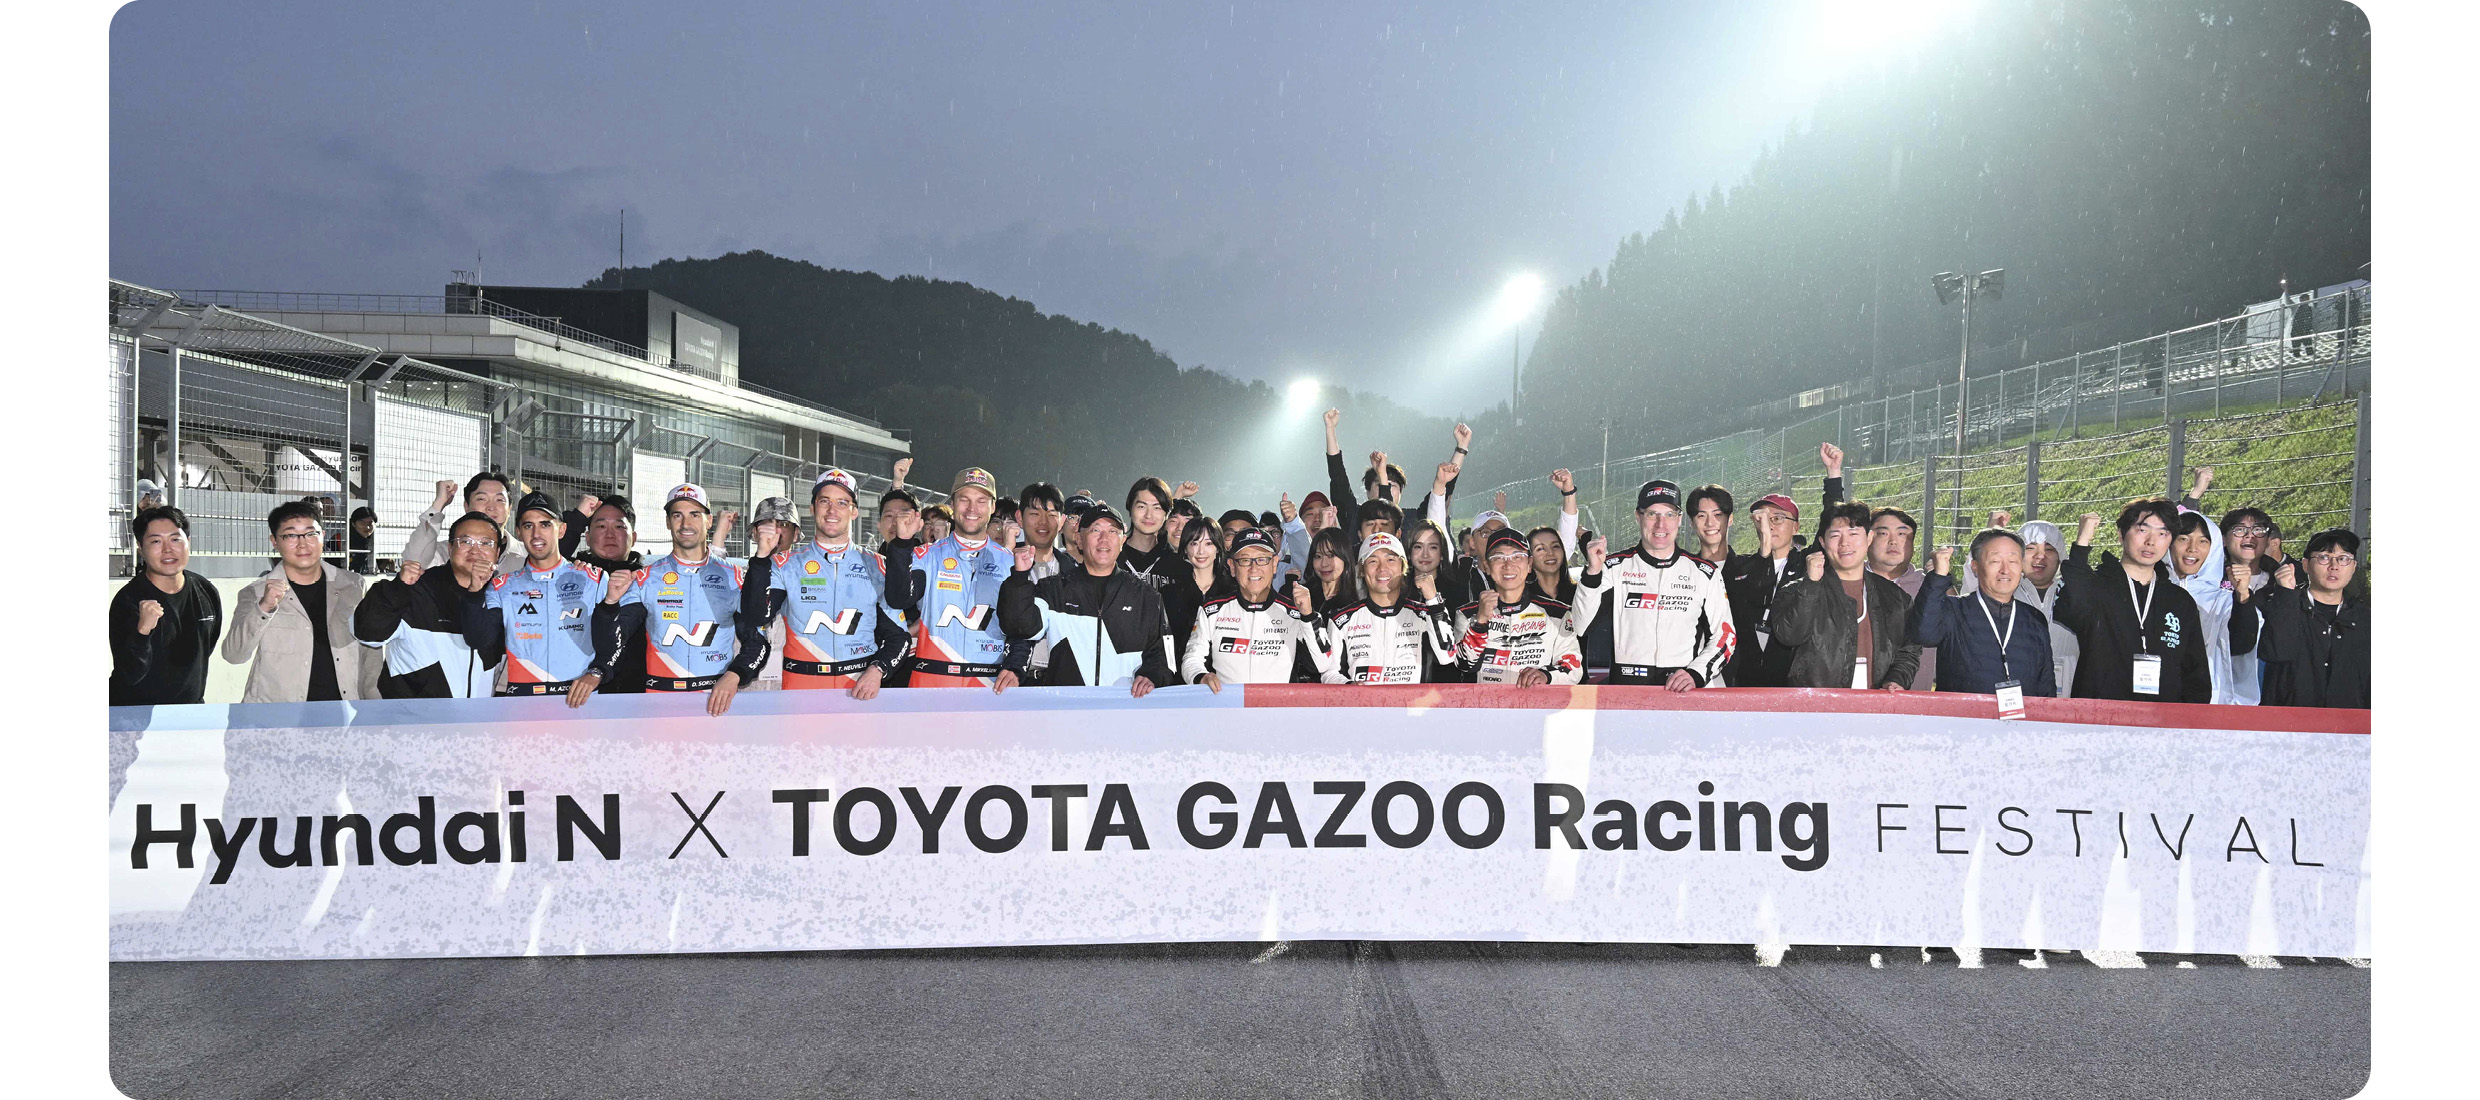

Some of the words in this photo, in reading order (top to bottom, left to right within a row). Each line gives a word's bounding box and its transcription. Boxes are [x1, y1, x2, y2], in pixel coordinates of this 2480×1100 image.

[1625, 596, 1656, 609] GR
[1489, 621, 1509, 633] OOKIE
[1511, 620, 1546, 633] RACING
[981, 643, 1003, 653] MOBIS
[1219, 640, 1249, 655] GR
[706, 654, 728, 662] MOBIS
[1483, 652, 1509, 665] GR
[844, 662, 868, 671] NEUVILLE
[1355, 669, 1381, 682] GR
[131, 790, 527, 885] Hyundai
[557, 793, 621, 862] N
[669, 791, 728, 860] X
[772, 783, 1150, 857] TOYOTA
[1177, 780, 1505, 850] GAZOO
[1533, 780, 1829, 872] Racing
[1877, 803, 2325, 868] FESTIVAL
